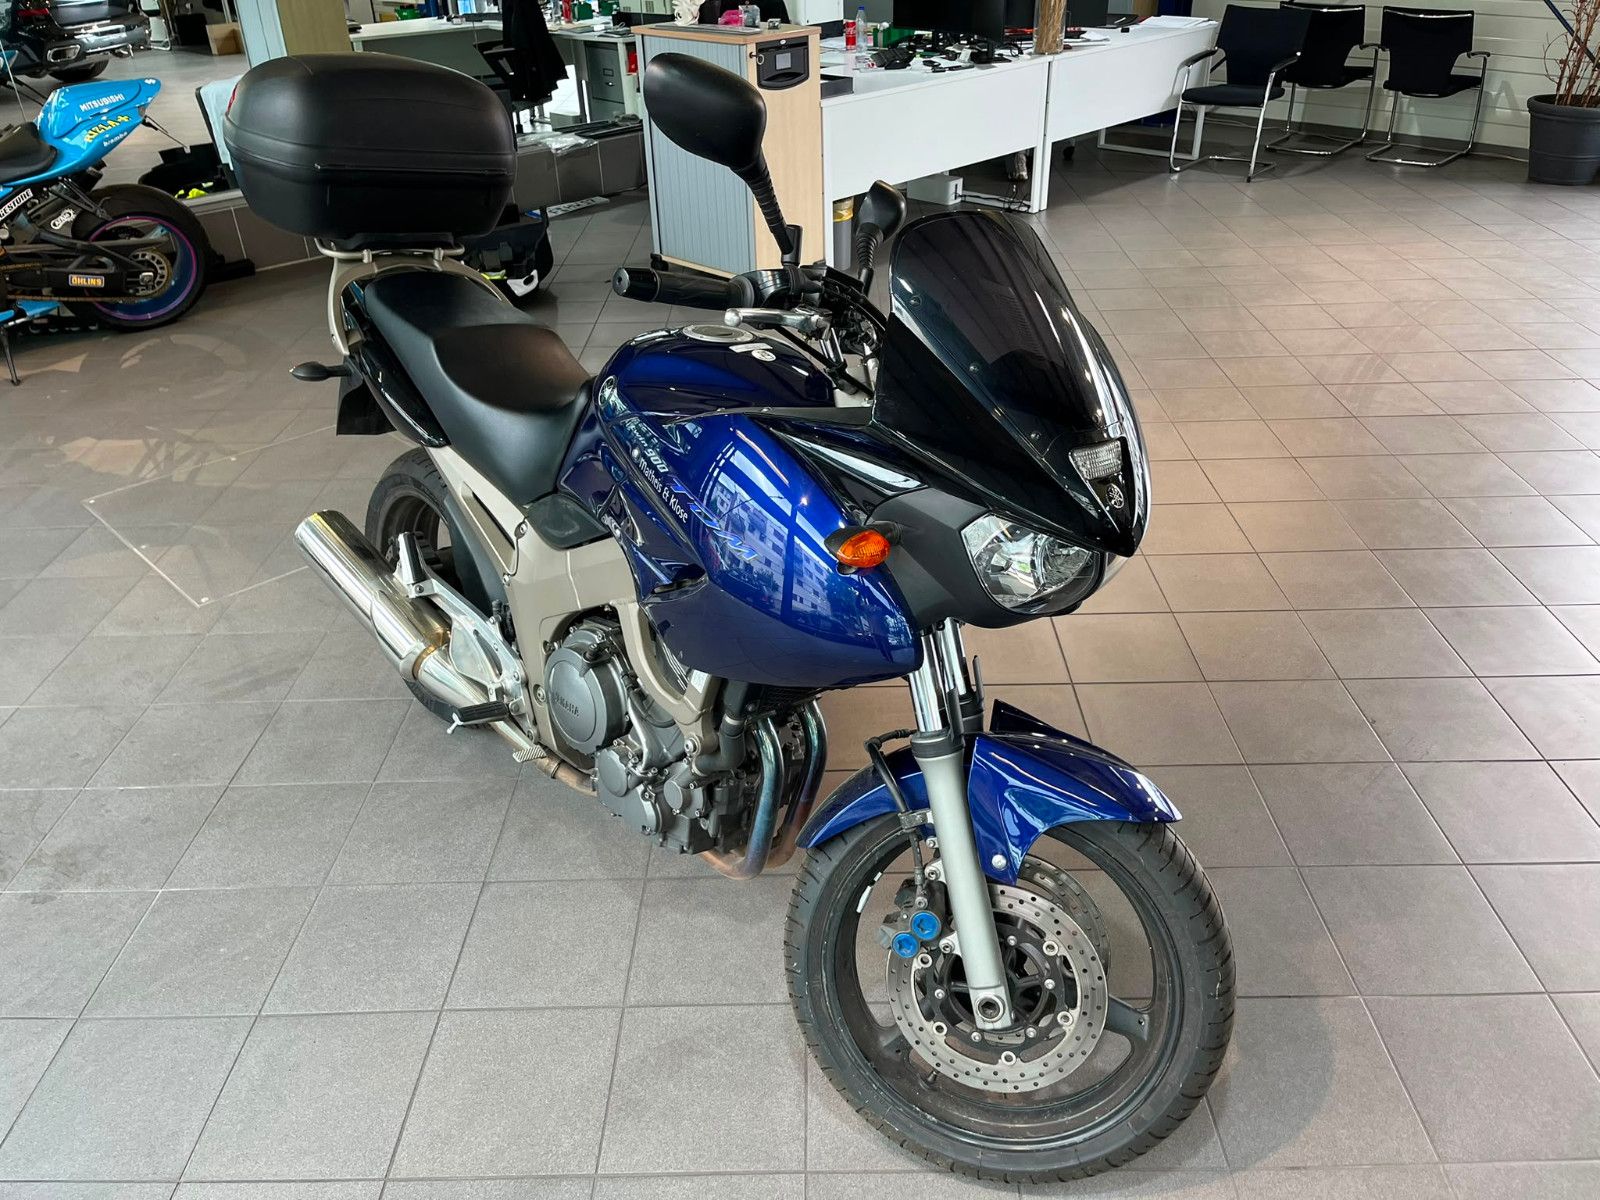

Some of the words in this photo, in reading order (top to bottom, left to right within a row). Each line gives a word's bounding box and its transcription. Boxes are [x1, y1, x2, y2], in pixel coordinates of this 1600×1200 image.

[80, 94, 125, 111] MITSUBISHI
[644, 448, 669, 473] 900
[639, 457, 663, 493] Matheis
[662, 487, 673, 503] &
[669, 494, 688, 523] Klose
